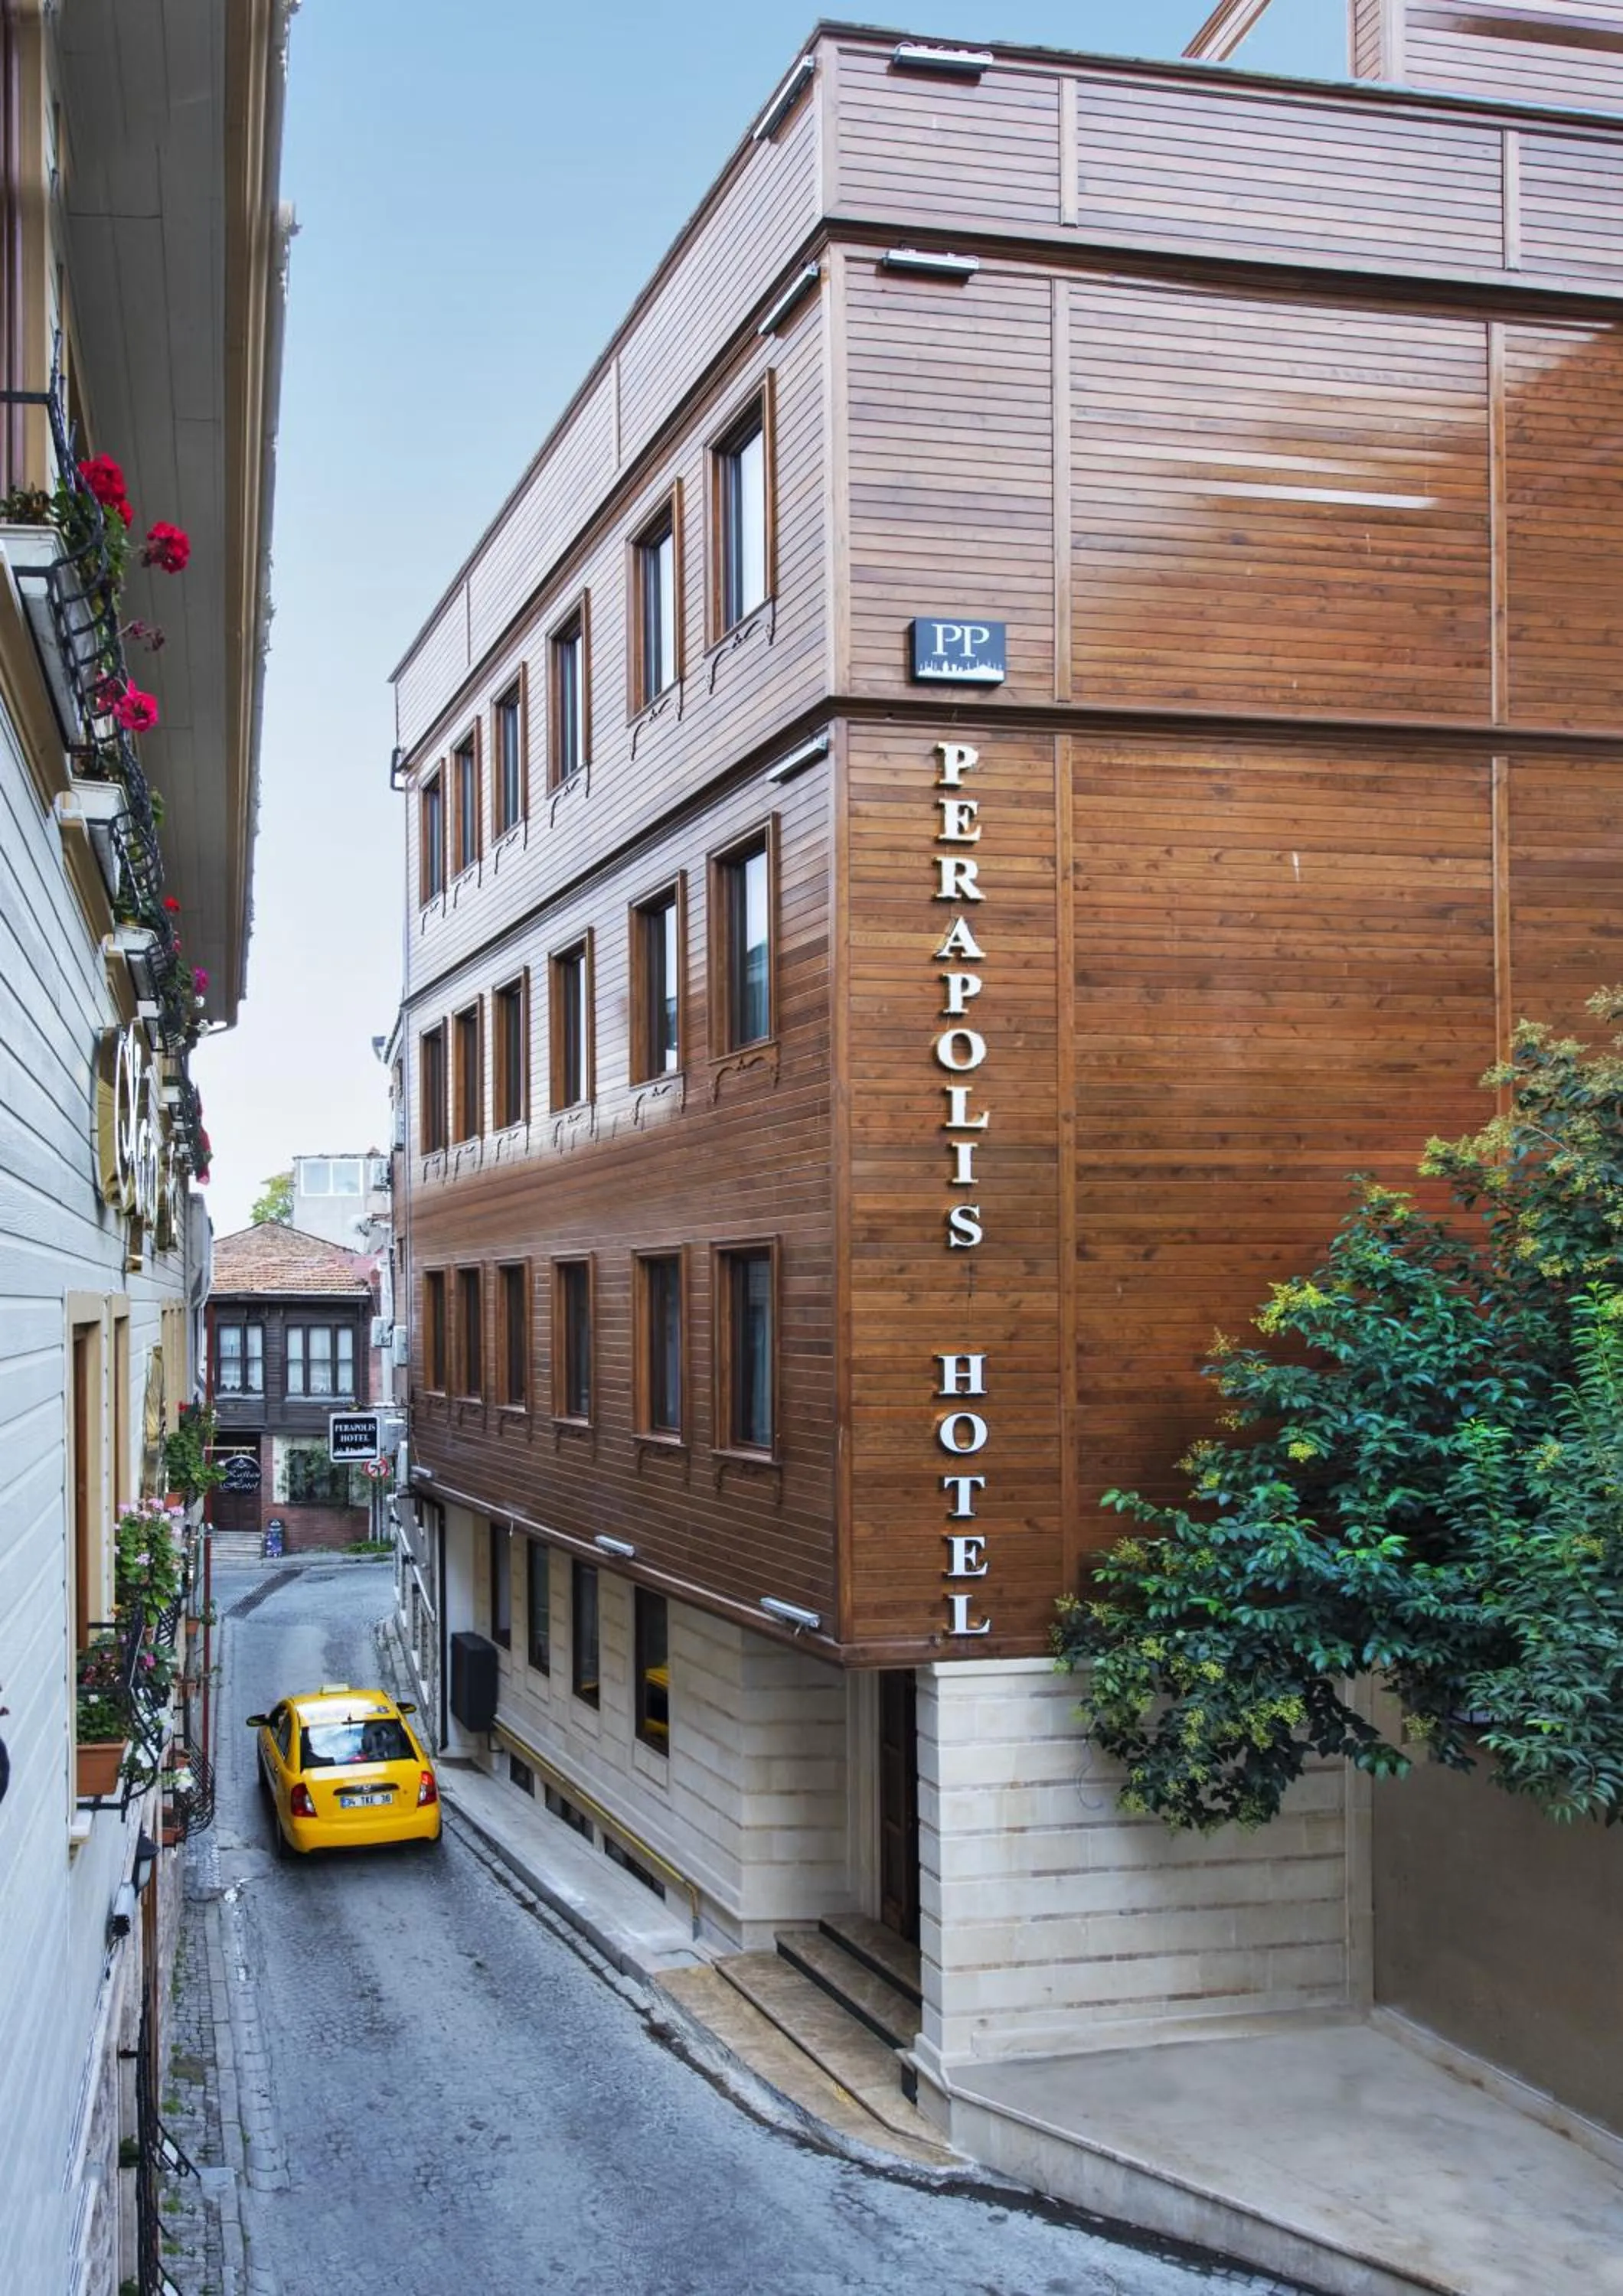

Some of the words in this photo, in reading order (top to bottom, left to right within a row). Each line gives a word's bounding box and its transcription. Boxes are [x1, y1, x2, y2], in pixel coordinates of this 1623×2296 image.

[931, 623, 990, 657] PP
[935, 741, 990, 1247] PERAPOLIS
[335, 1424, 376, 1432] PERAPOLIS
[340, 1434, 370, 1443] HOTEL
[936, 1353, 991, 1635] HOTEL
